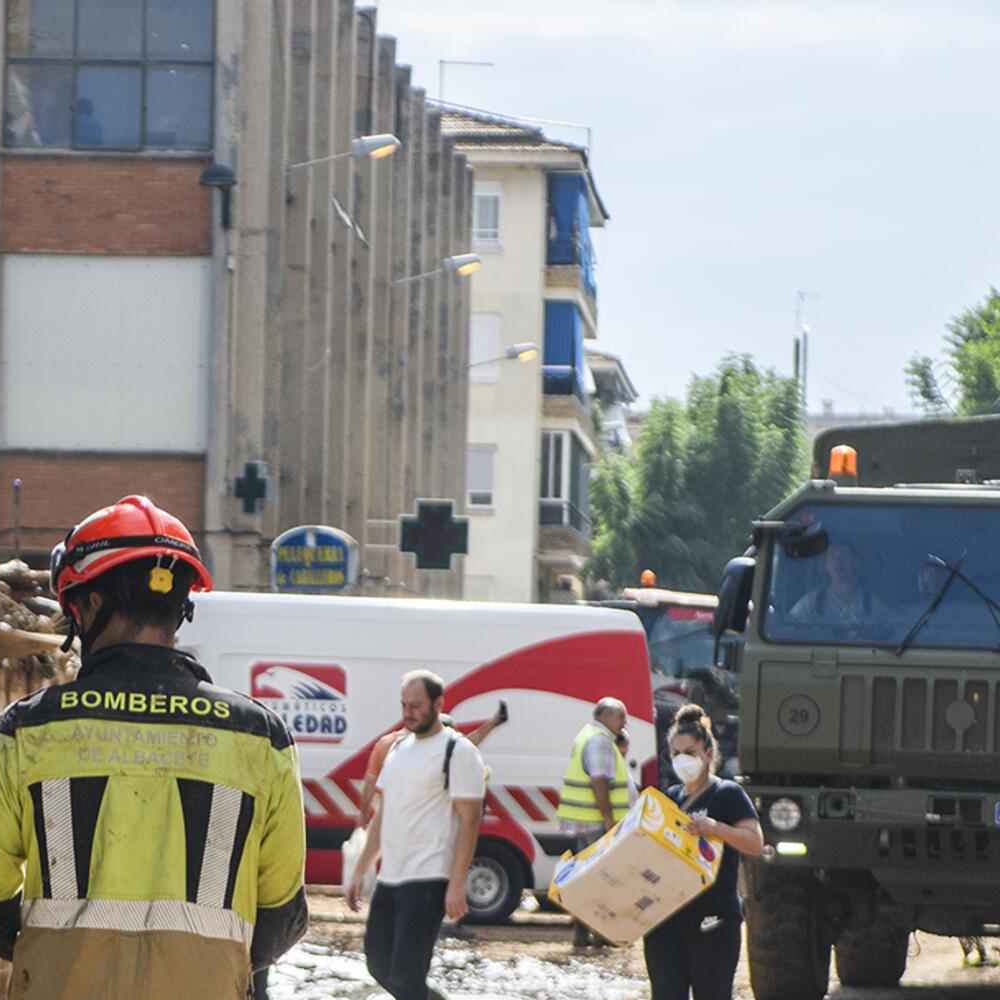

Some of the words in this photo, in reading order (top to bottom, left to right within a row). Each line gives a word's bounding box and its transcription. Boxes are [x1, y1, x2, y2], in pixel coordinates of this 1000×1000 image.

[60, 690, 231, 719] BOMBEROS
[789, 708, 809, 722] 29
[71, 725, 218, 748] AYUNTAMIENTO
[77, 746, 101, 762] DE
[107, 747, 210, 769] ALBACETE
